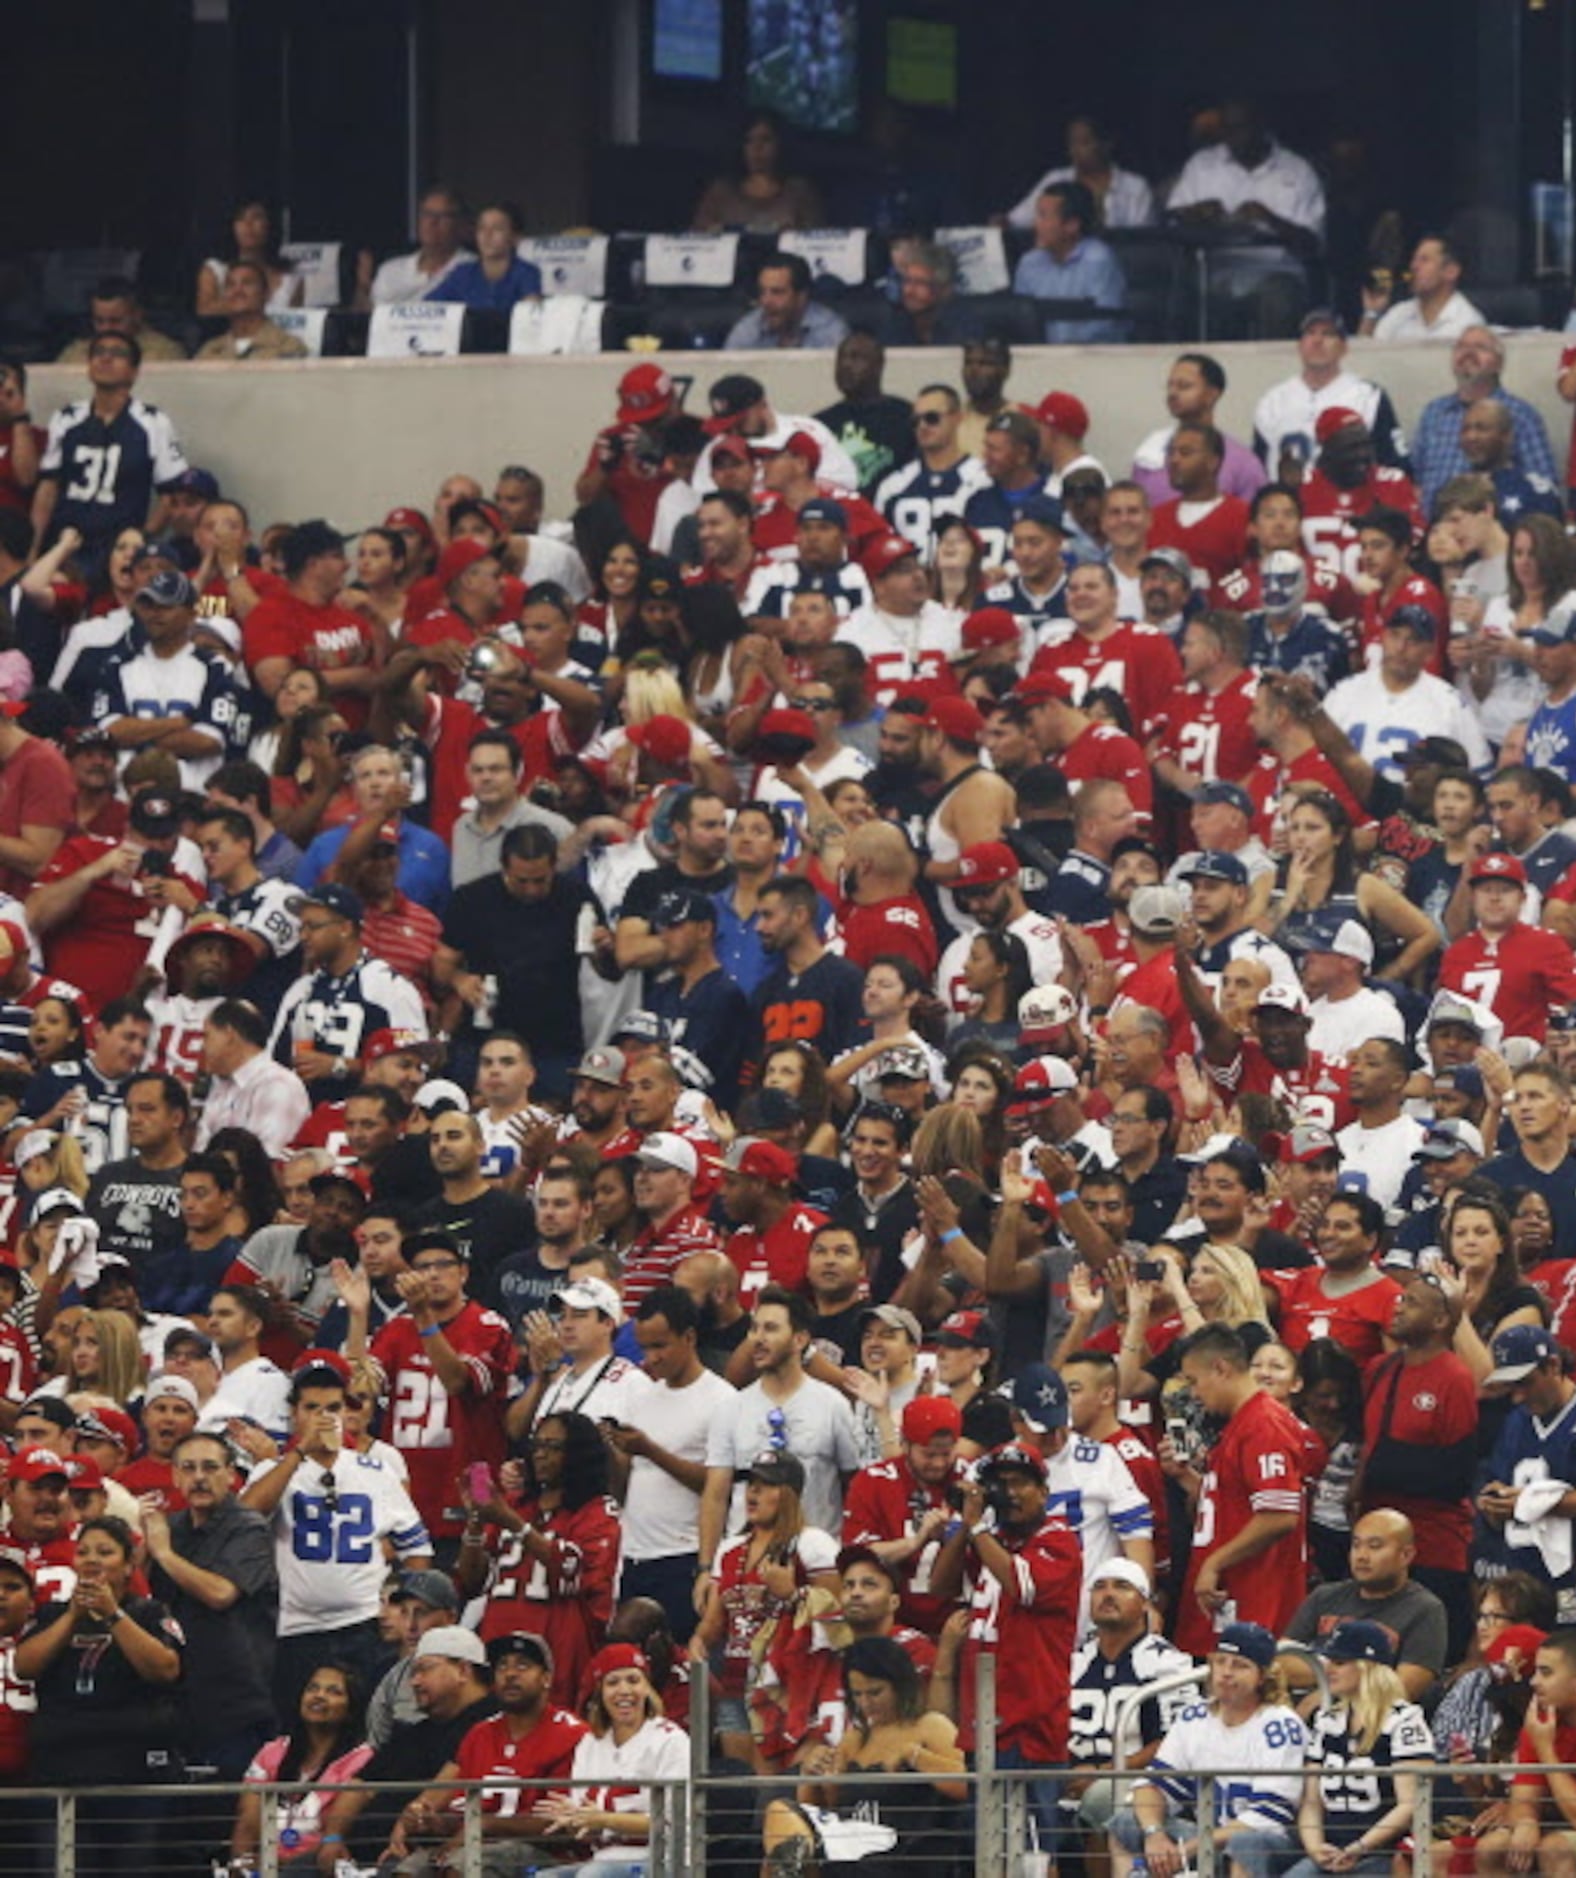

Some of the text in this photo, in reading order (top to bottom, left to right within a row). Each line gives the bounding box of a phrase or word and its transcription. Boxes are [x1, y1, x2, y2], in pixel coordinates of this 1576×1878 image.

[67, 444, 122, 504] 31
[1181, 734, 1221, 782] 21
[1462, 969, 1502, 1010] 7
[101, 1183, 184, 1218] COWBOYS
[392, 1370, 454, 1449] 21
[1258, 1453, 1286, 1480] 16
[292, 1493, 374, 1563] 82
[1266, 1718, 1304, 1749] 88
